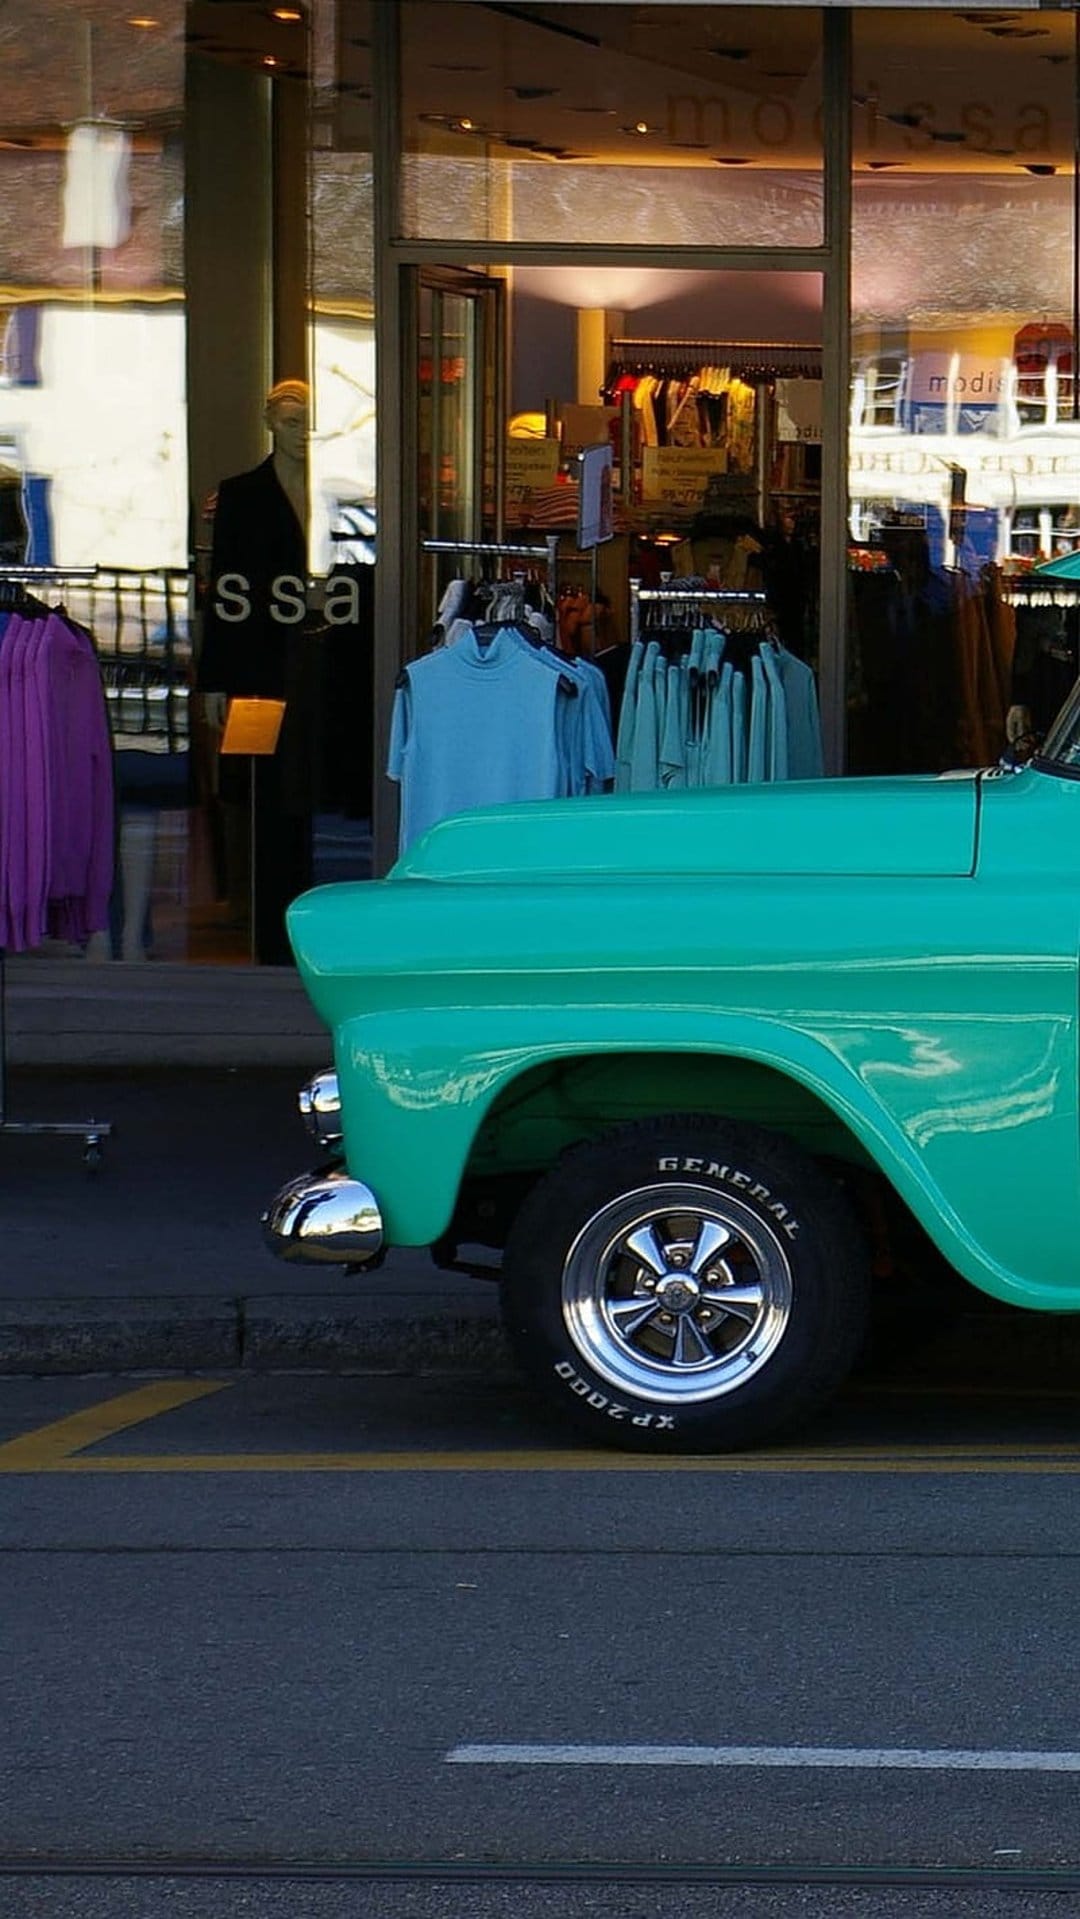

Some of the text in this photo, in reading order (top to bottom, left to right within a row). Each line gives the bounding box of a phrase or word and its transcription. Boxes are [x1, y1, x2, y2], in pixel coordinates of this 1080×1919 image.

[666, 81, 1052, 152] moissa
[657, 1156, 803, 1241] GENERAL
[553, 1359, 679, 1431] XP2000
